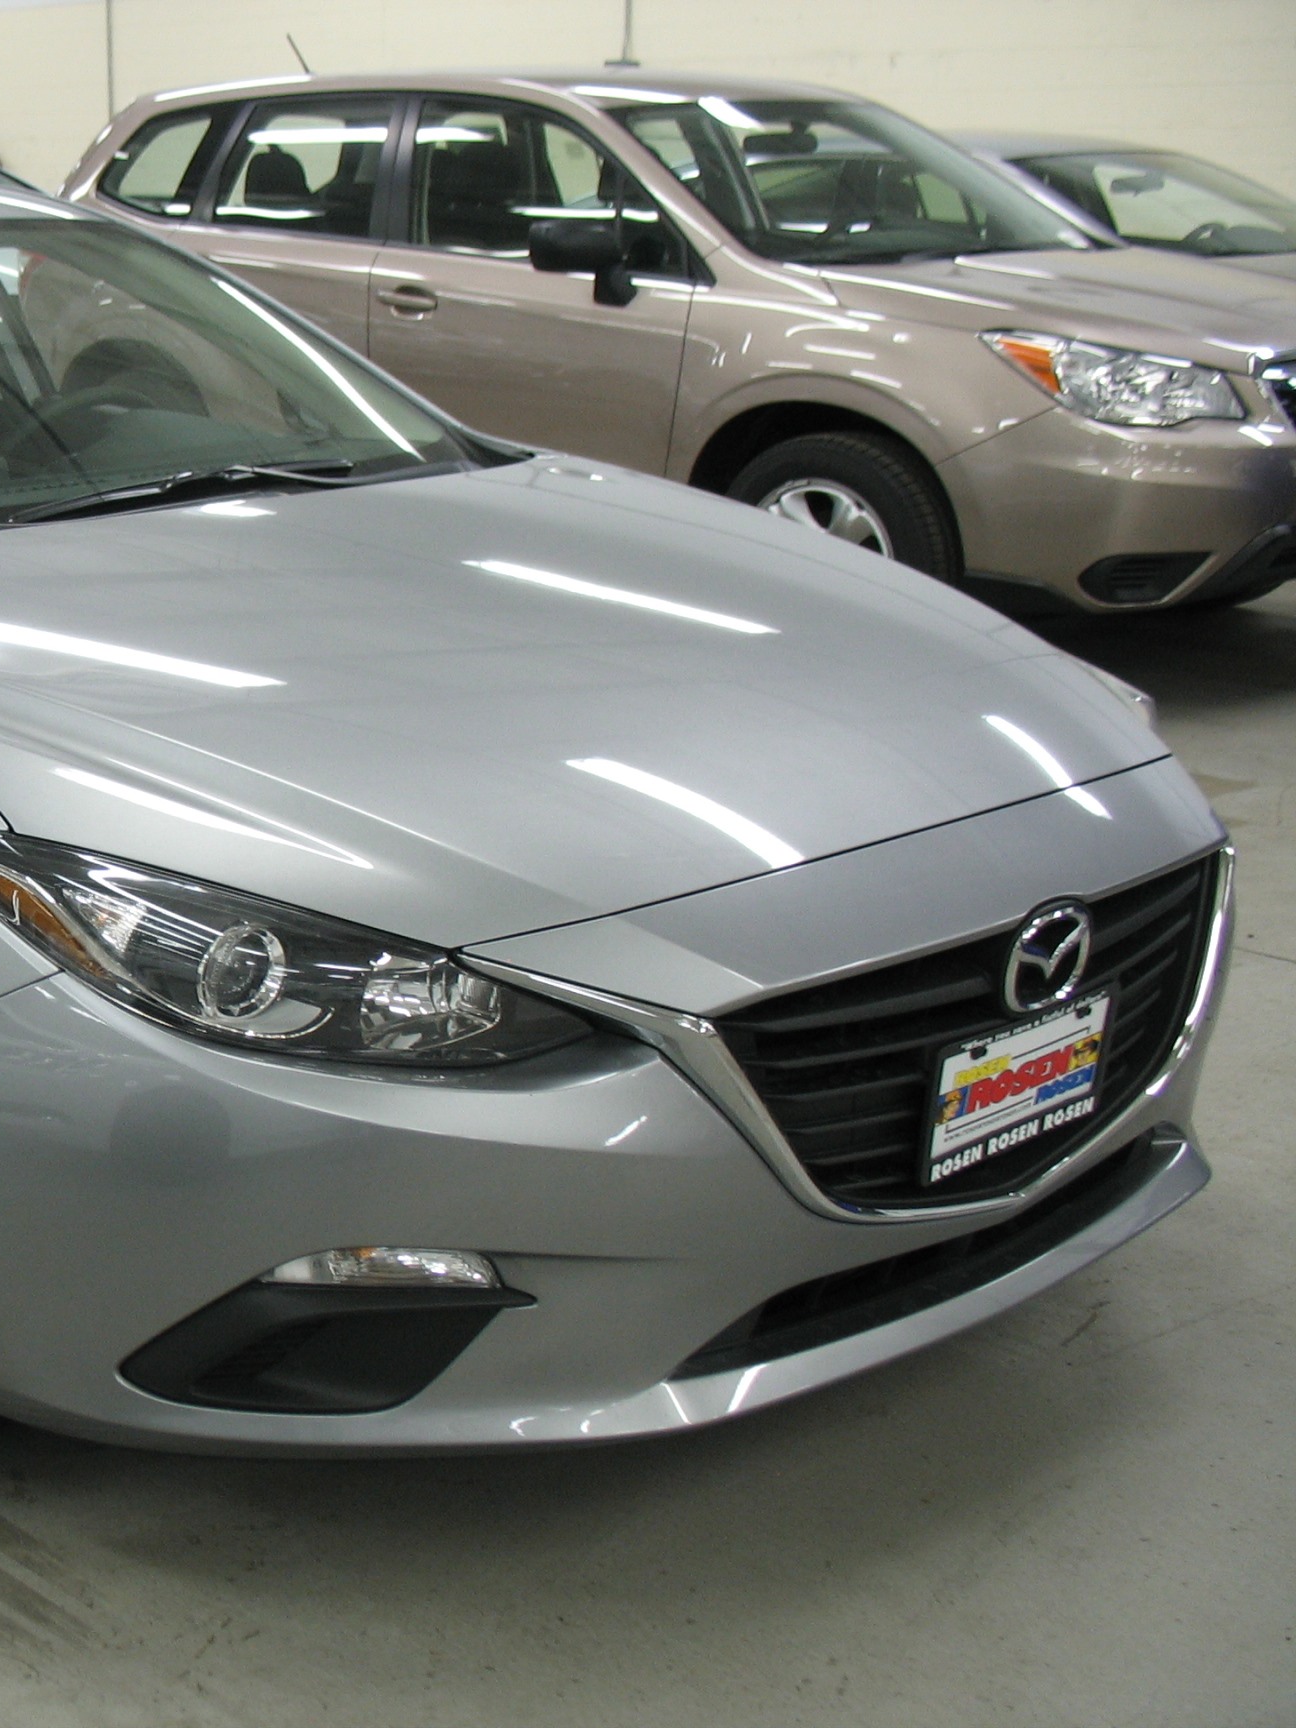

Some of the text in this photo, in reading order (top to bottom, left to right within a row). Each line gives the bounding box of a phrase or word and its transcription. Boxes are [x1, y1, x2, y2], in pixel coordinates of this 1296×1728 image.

[966, 1043, 1075, 1114] ROSEN
[930, 1143, 983, 1183] ROSEN
[986, 1118, 1039, 1156] ROSEN
[1043, 1096, 1095, 1131] ROSEN
